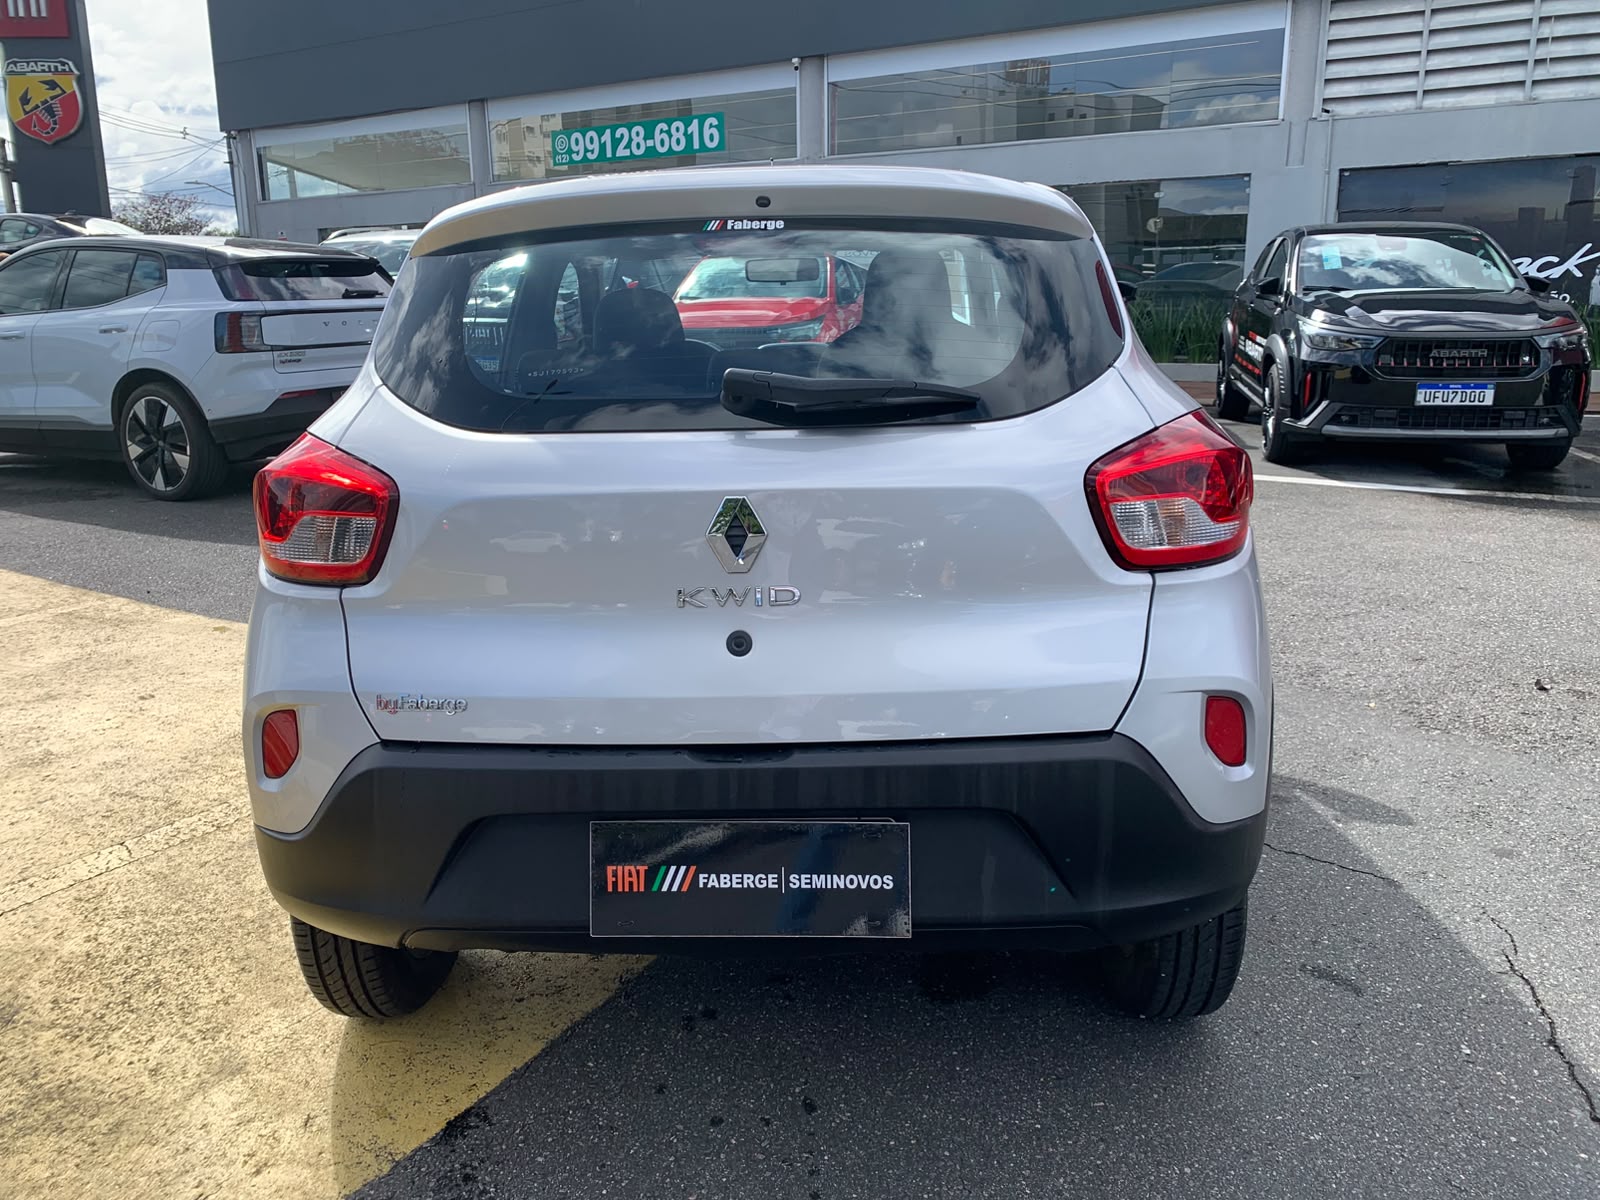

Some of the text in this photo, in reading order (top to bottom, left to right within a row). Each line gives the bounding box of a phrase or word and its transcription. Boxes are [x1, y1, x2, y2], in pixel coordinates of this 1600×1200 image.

[6, 62, 69, 72] ABARTH
[570, 117, 720, 162] 99128-6816
[556, 154, 569, 163] (12)
[726, 219, 785, 230] Faberge
[1429, 348, 1488, 358] ABARTH
[1423, 390, 1487, 404] UFU7D00
[677, 585, 802, 608] KWID
[606, 865, 895, 892] FIAT FABERGE SEMINOVOS
